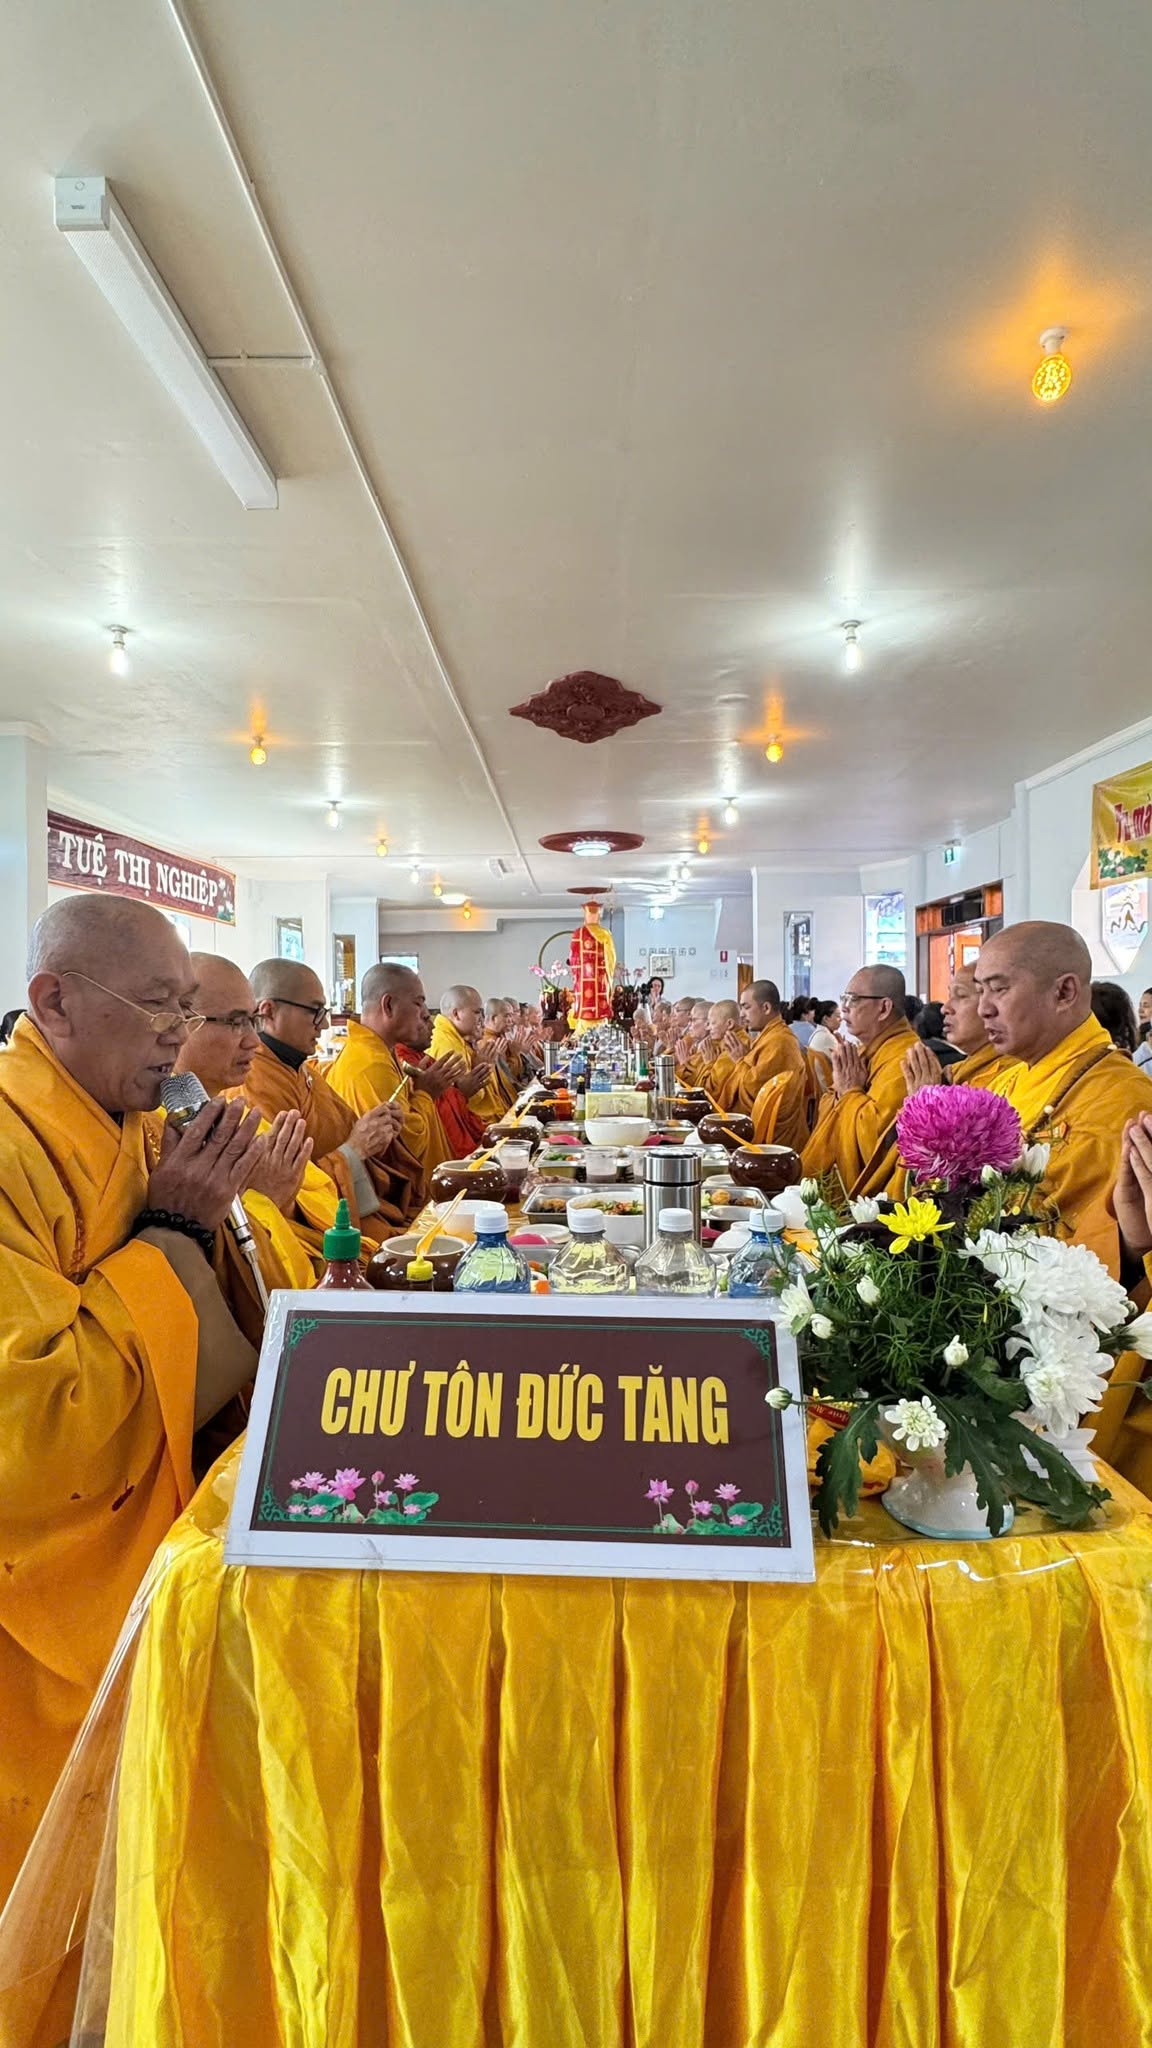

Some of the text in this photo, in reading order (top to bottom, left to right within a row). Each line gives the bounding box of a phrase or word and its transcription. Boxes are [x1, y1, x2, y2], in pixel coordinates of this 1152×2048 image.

[59, 831, 218, 911] TUỆ THỊ NGHIỆP
[320, 1360, 730, 1445] CHƯ TÔN ĐỨC TĂNG
